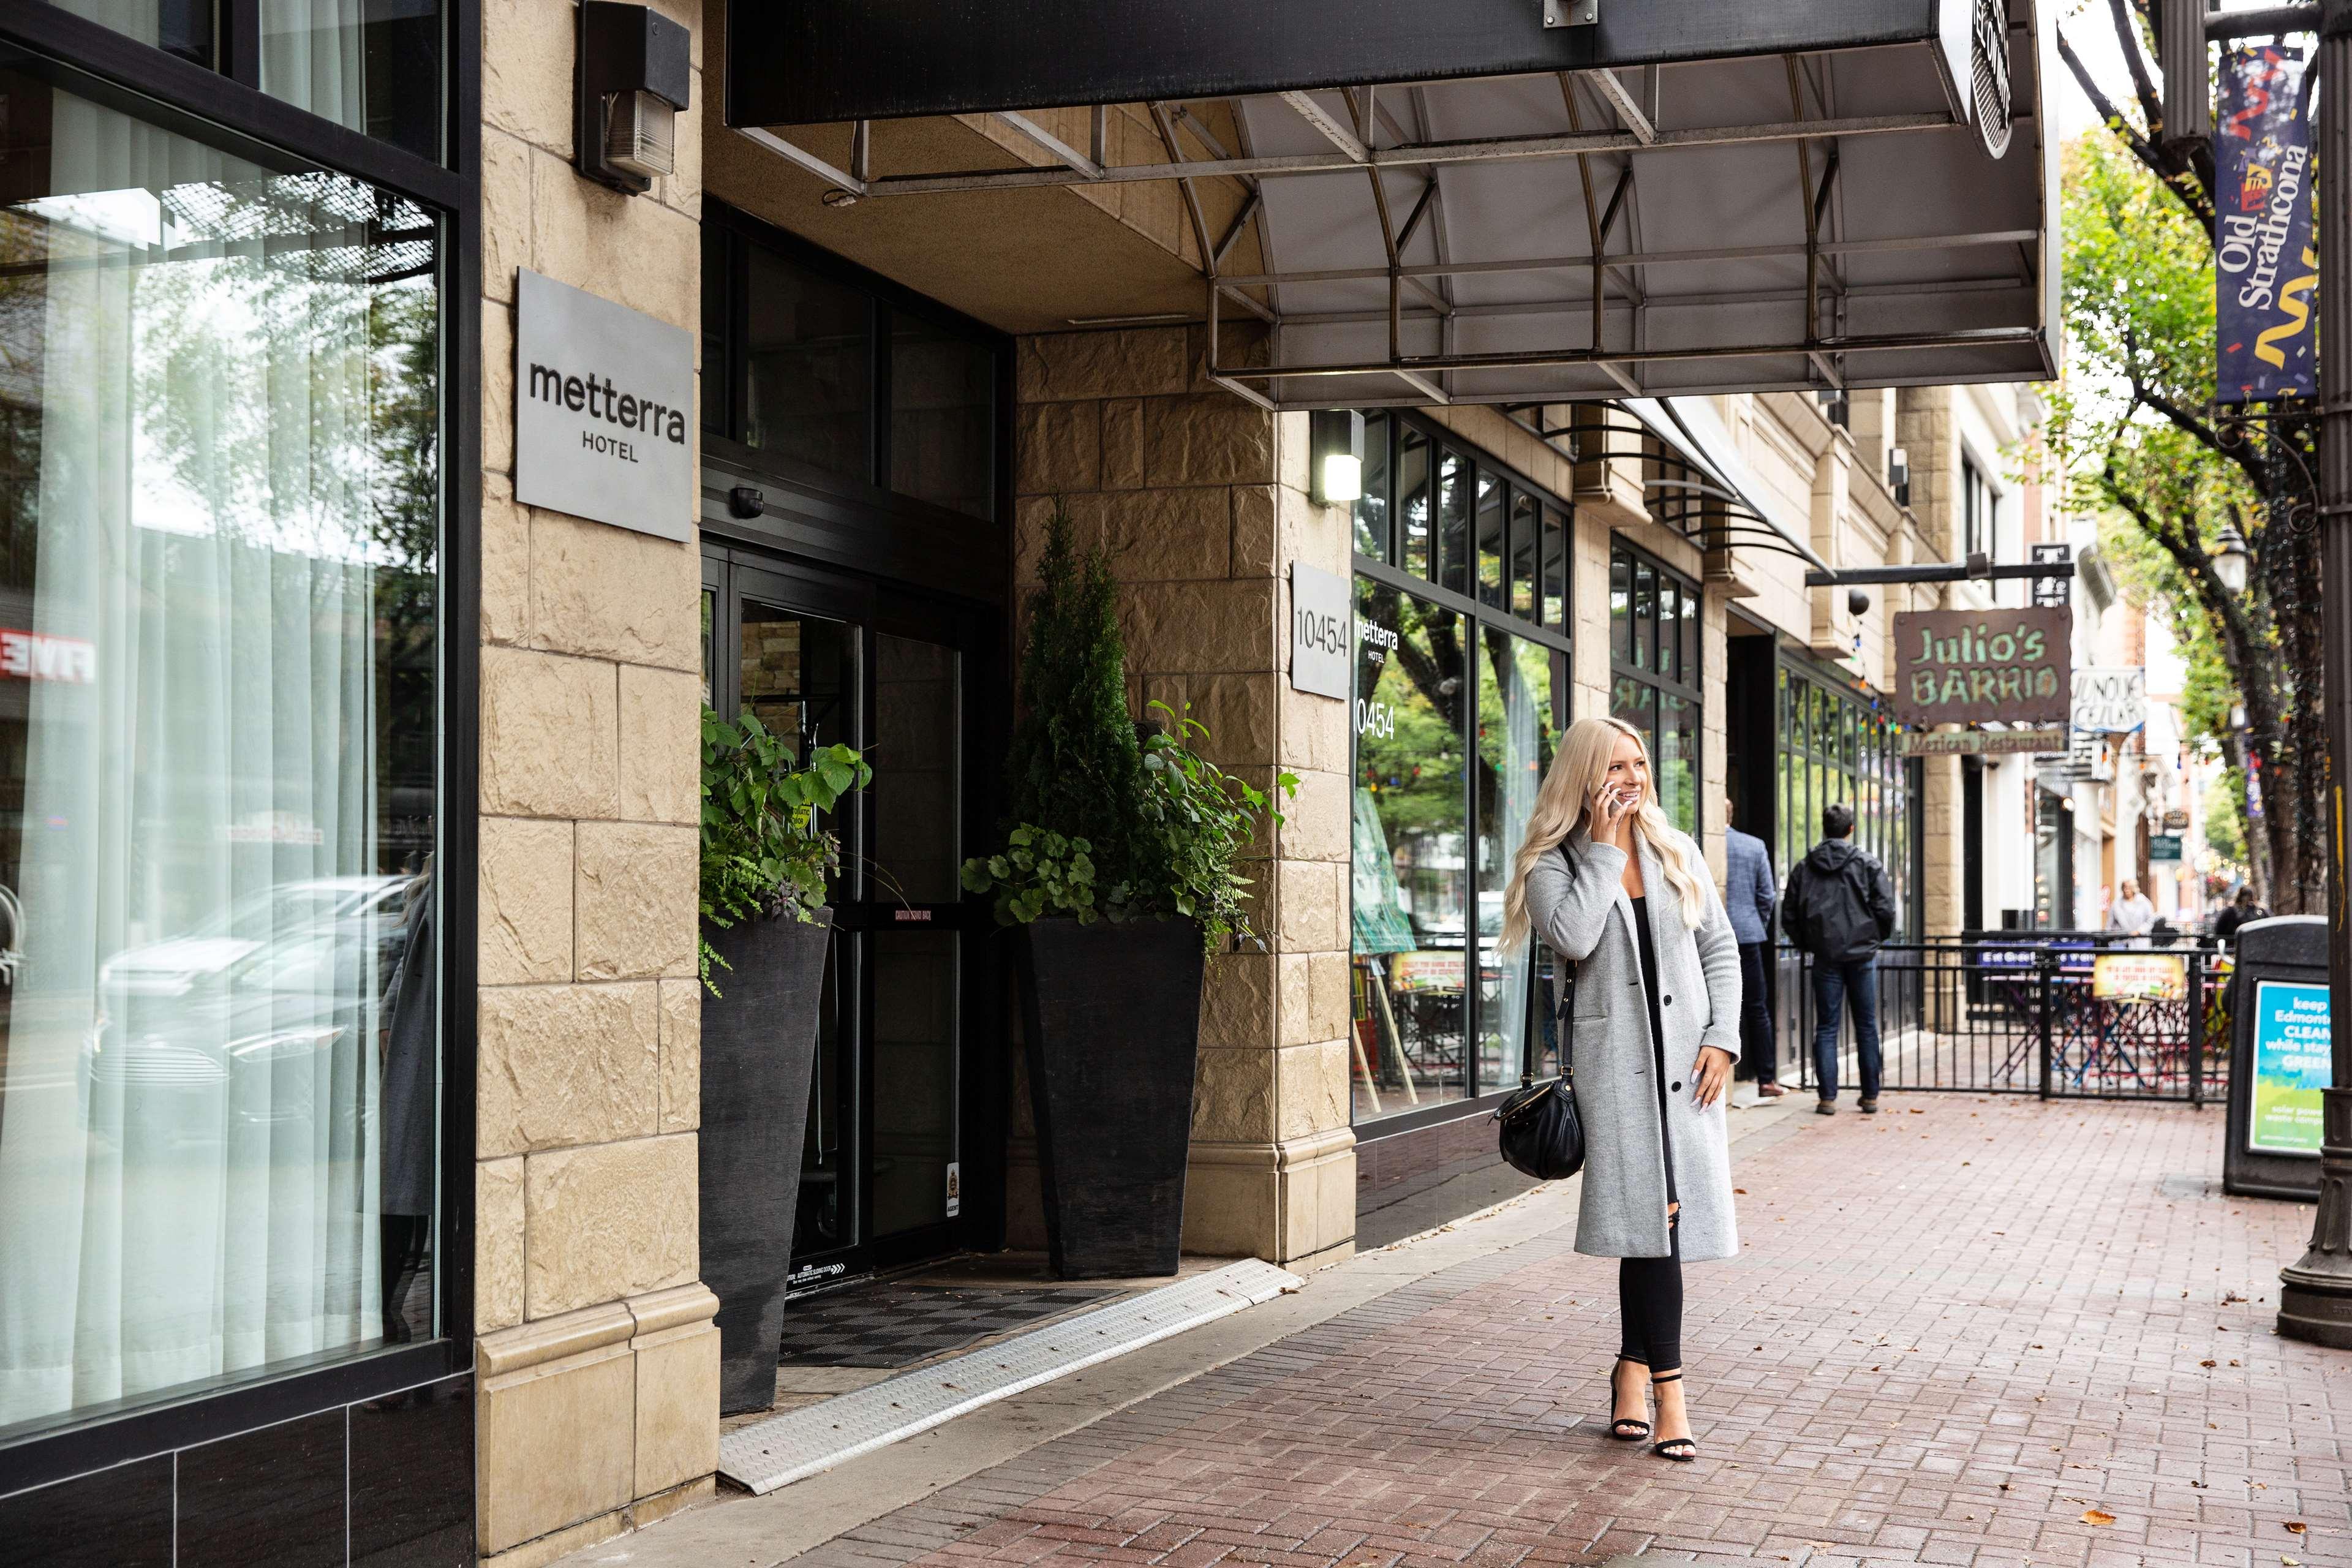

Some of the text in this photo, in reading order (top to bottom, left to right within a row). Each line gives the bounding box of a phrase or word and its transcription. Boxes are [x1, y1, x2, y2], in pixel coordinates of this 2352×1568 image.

[2218, 214, 2257, 273] Old
[2239, 145, 2308, 311] Strathcona
[530, 363, 685, 445] metterra
[582, 431, 638, 463] HOTEL
[1297, 606, 1348, 657] 10454
[1354, 620, 1398, 650] metterra
[1910, 622, 2047, 665] Julio's
[1368, 650, 1385, 663] HOTEL
[1910, 665, 2060, 706] BARRIO
[2275, 1009, 2331, 1025] Edmont
[2293, 997, 2328, 1013] keep
[2266, 1038, 2301, 1052] while
